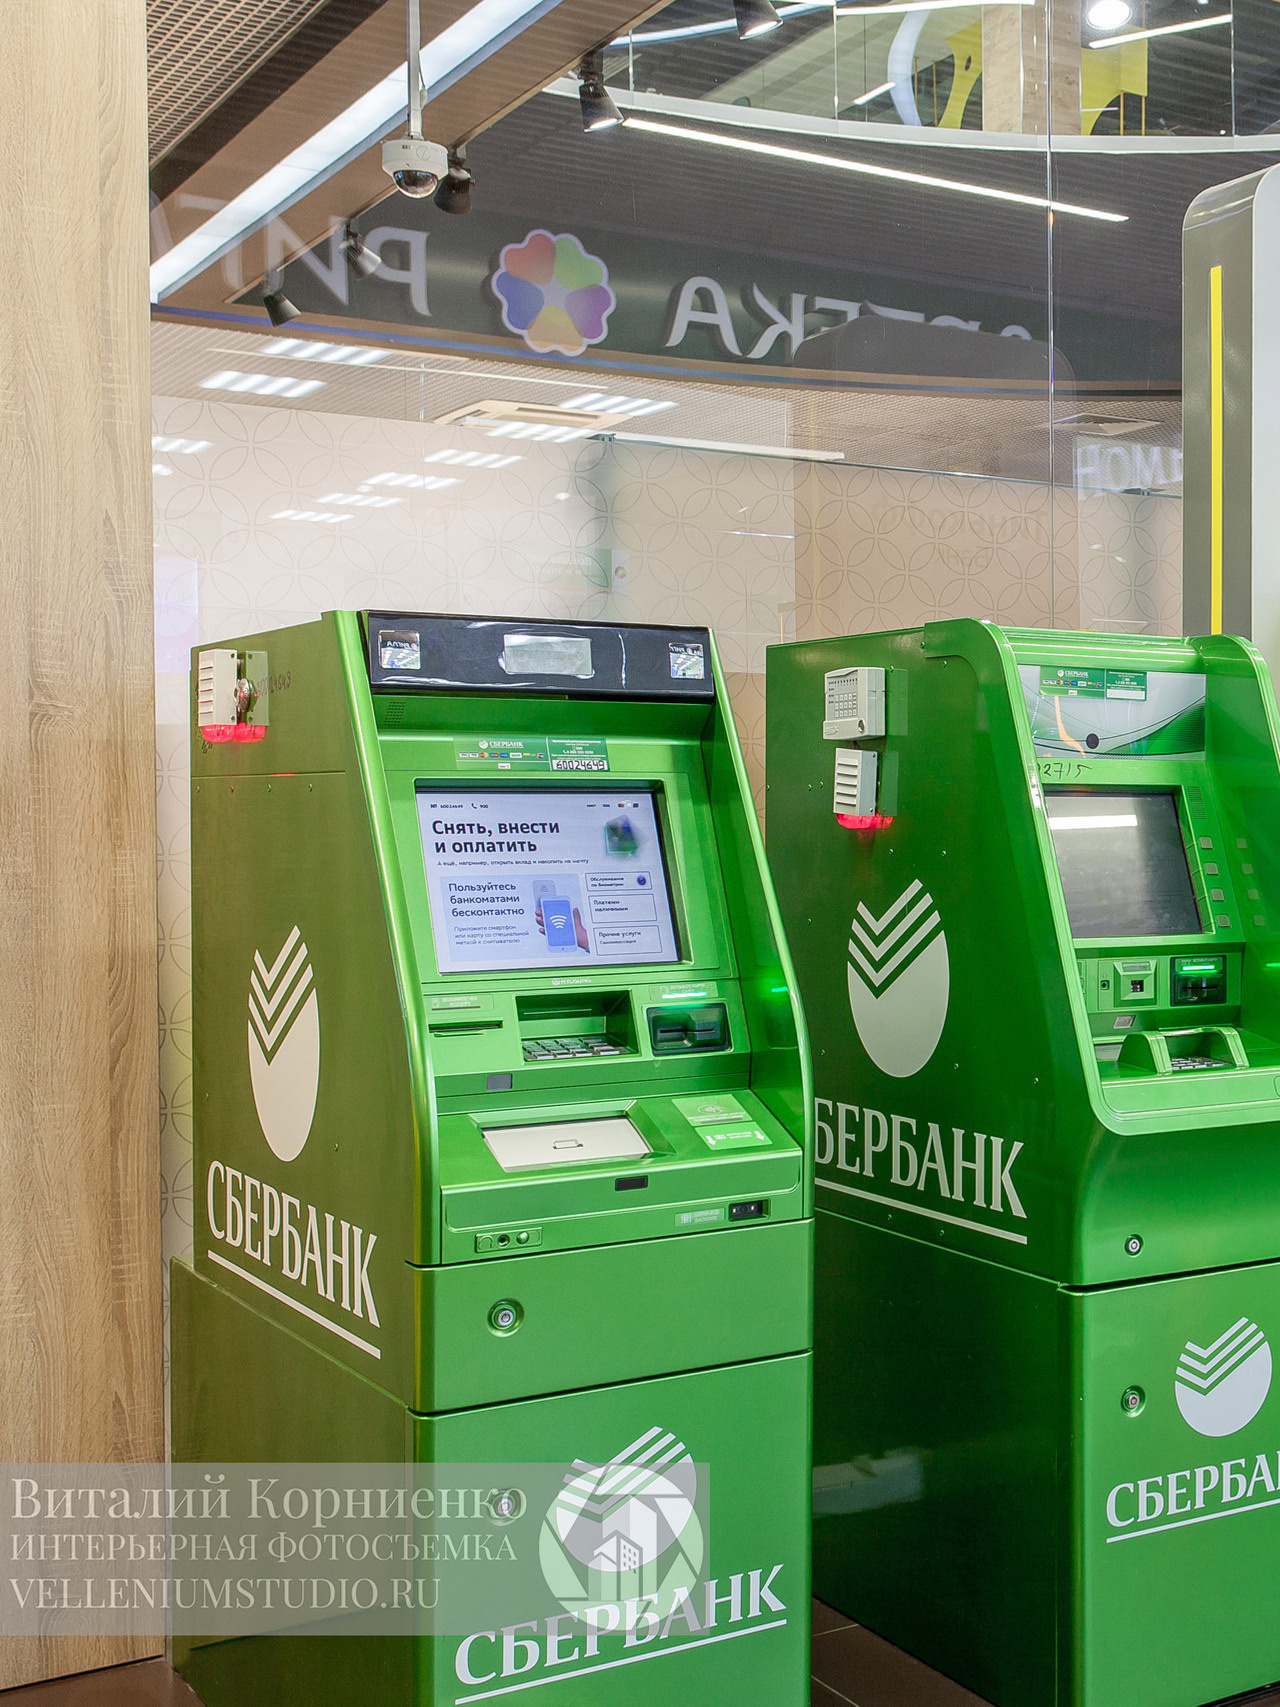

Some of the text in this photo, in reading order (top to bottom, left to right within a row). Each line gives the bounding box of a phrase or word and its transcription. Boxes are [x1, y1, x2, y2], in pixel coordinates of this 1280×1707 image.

[432, 820, 560, 837] Снять, внести
[435, 840, 537, 853] и оплатить
[449, 882, 516, 894] Пользуйтесь
[450, 895, 520, 904] банкоматами
[451, 907, 525, 917] бесконтактно
[814, 1097, 1028, 1219] БЕРБАНК
[207, 1160, 381, 1329] СБЕРБАНК
[455, 1563, 787, 1686] СБЕРБАНК
